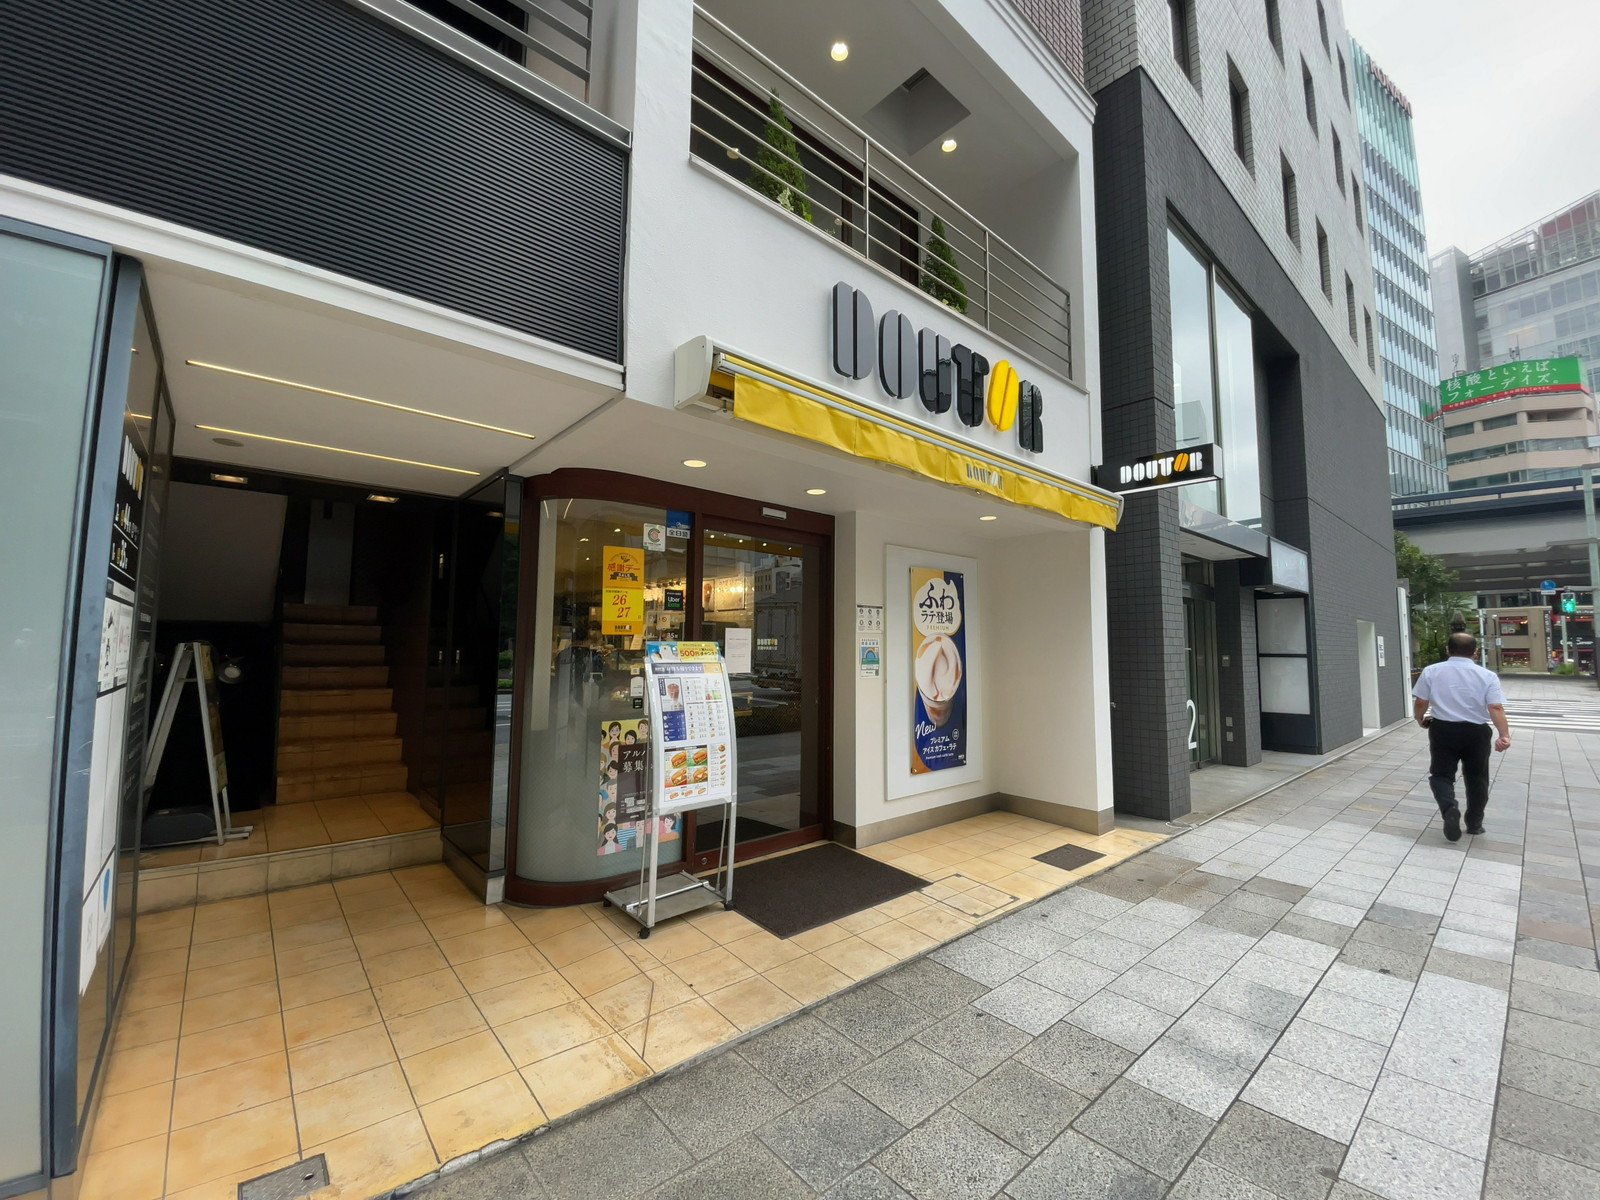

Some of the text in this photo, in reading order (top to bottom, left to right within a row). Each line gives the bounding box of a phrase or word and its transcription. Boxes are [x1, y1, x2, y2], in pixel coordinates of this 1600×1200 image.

[832, 280, 1044, 454] DOUTOR
[1446, 360, 1558, 391] 核酸といえば、
[966, 463, 1003, 490] DOUTOR
[1120, 451, 1203, 484] DOUTOR
[607, 562, 640, 572] 感謝デー
[612, 594, 627, 605] 26
[919, 582, 955, 610] ふわ
[617, 607, 631, 618] 27
[921, 610, 953, 624] ラテ登場
[915, 720, 937, 739] New
[1186, 699, 1197, 750] 2
[930, 735, 950, 745] プレミアム
[622, 759, 644, 773] 募集
